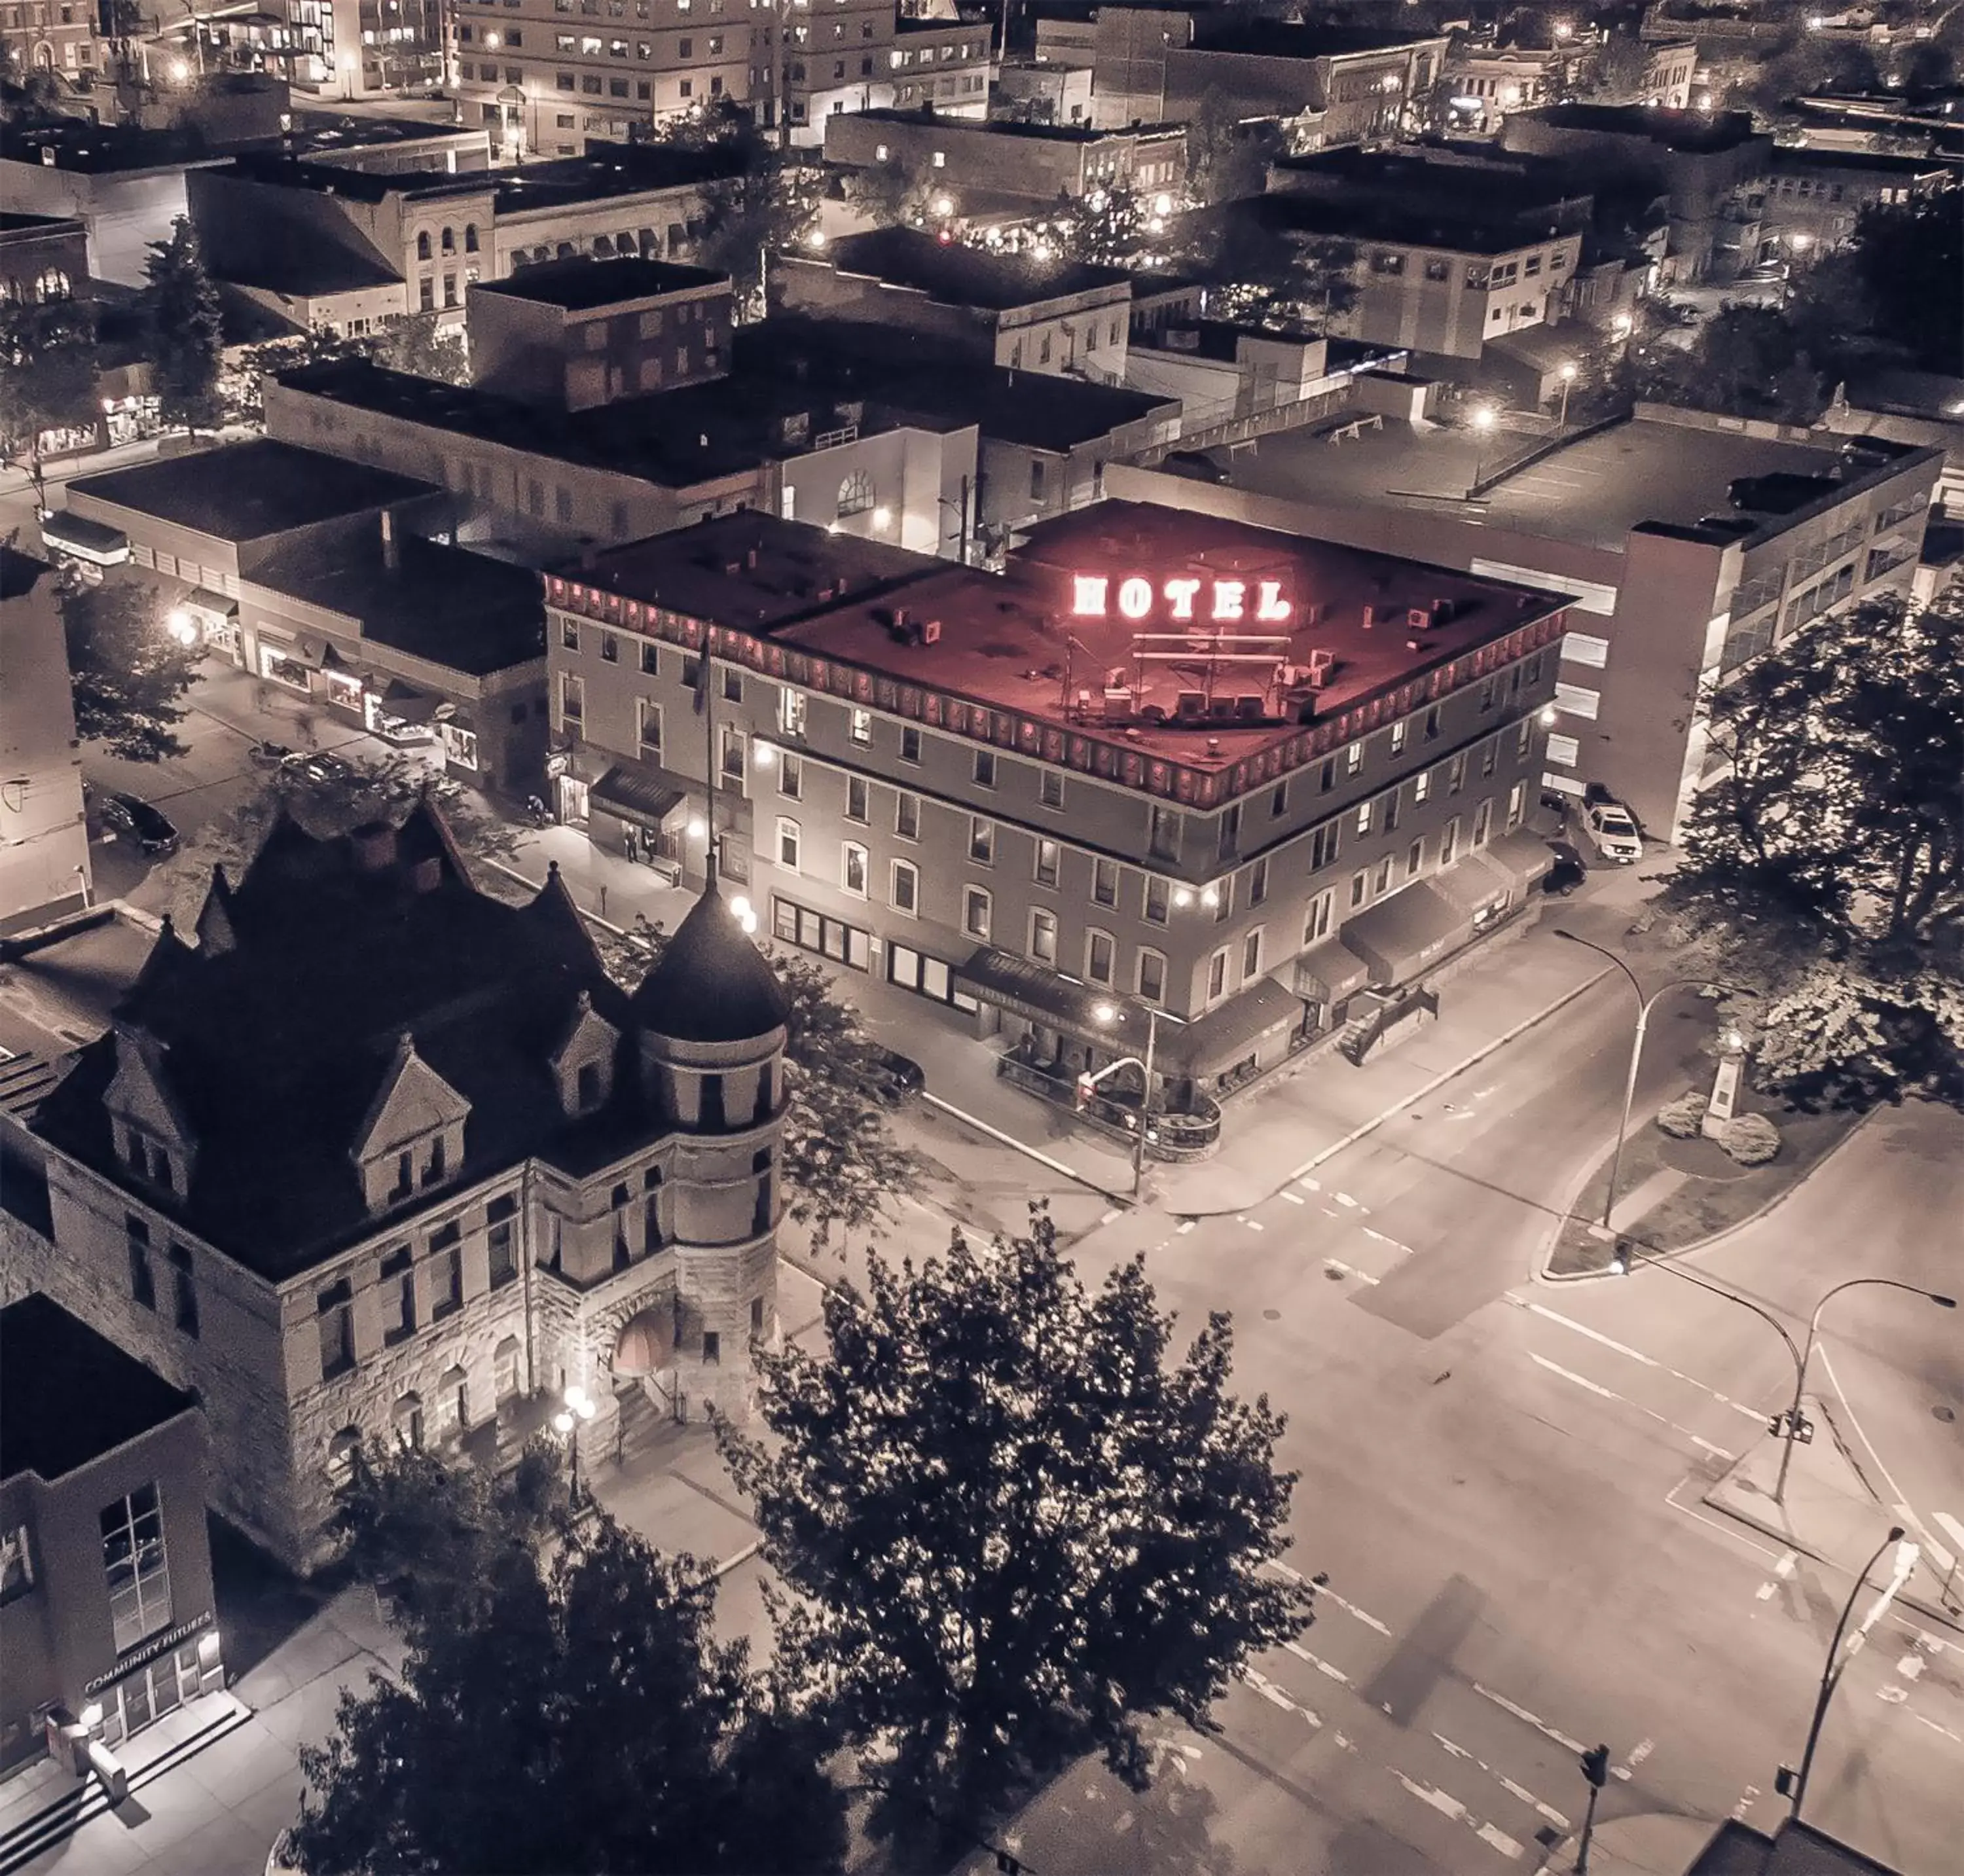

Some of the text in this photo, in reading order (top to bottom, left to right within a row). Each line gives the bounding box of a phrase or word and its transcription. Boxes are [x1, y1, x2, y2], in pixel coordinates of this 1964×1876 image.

[1072, 575, 1291, 621] HOTEL
[84, 1610, 211, 1693] COMMUNITY FUTURES
